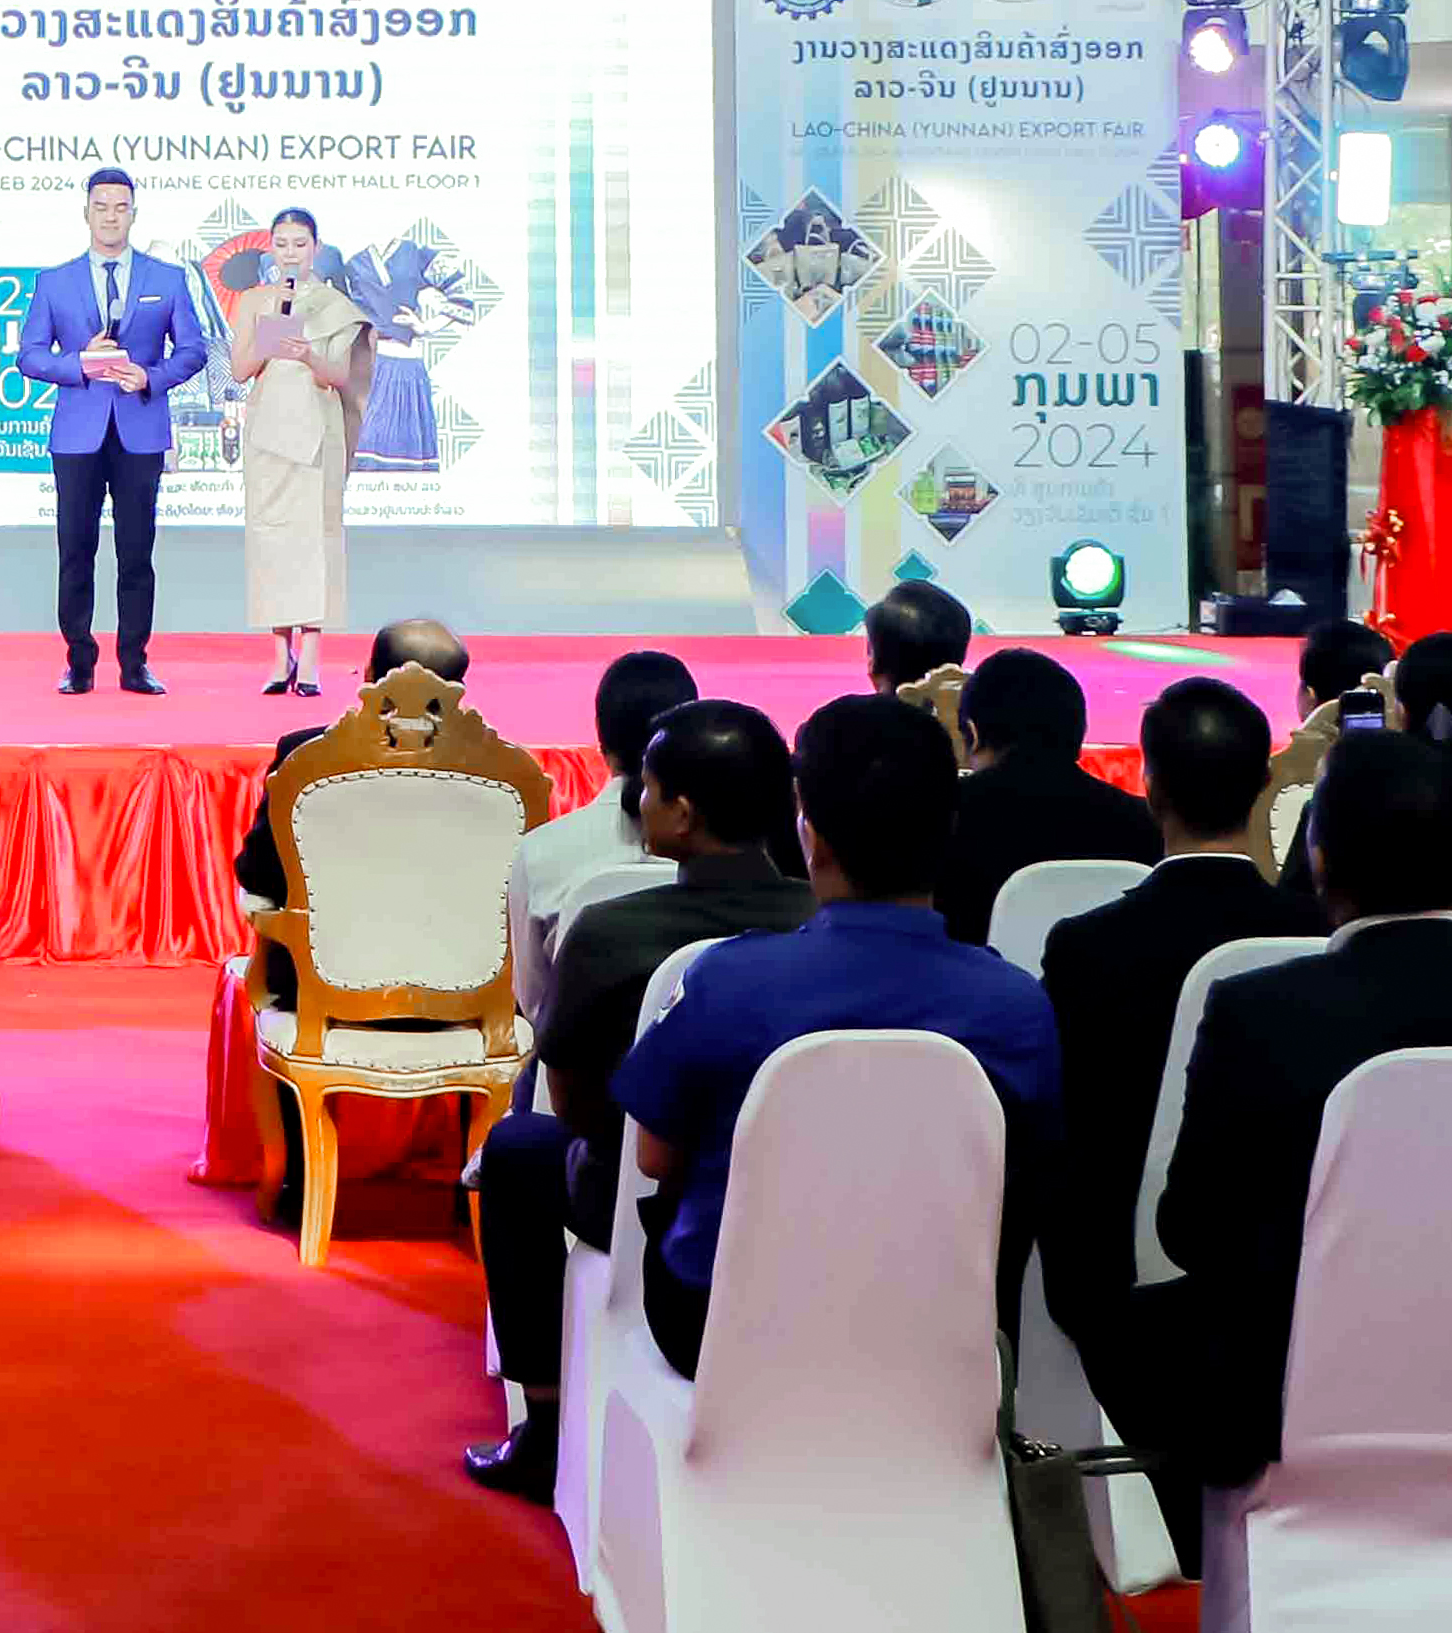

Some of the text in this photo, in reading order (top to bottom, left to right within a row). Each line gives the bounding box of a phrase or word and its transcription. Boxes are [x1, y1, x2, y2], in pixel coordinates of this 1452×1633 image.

[112, 132, 271, 165] (YUNNAN)
[281, 135, 401, 161] EXPORT
[412, 134, 477, 161] FAIR
[791, 120, 1144, 140] LAO-CHINA (YUNNAN) EXPORT FAIR
[30, 175, 75, 191] 2024
[208, 174, 282, 190] CENTER
[287, 174, 347, 190] EVENT
[352, 173, 400, 190] HALL
[405, 173, 467, 190] FLOOR
[1009, 322, 1161, 366] 02-05
[1011, 371, 1160, 424] ກຸມພາ
[1012, 423, 1158, 468] 2024
